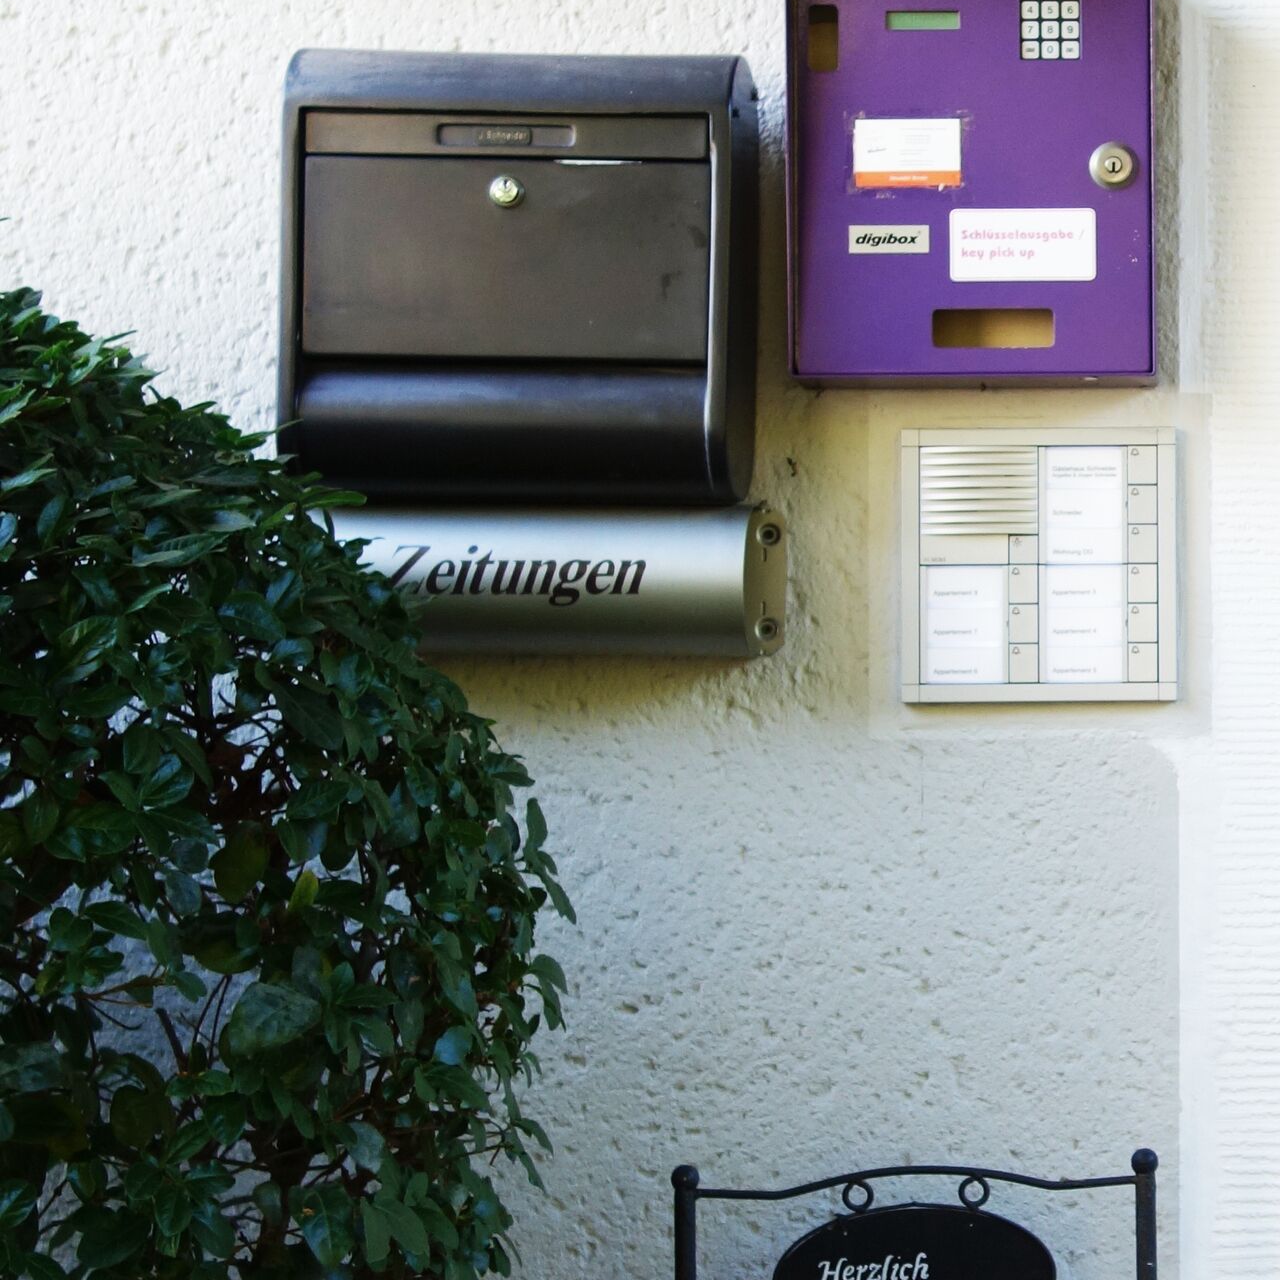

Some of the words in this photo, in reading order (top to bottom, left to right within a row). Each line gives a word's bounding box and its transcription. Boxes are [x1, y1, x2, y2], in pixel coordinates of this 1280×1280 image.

[1026, 6, 1033, 14] 4
[1047, 6, 1053, 14] 5
[1067, 6, 1073, 14] 6
[1027, 25, 1033, 33] 7
[1047, 25, 1053, 33] 8
[1067, 25, 1073, 33] 9
[1046, 45, 1054, 53] 0
[855, 233, 918, 247] digibox
[961, 229, 1074, 242] Schlüsselausgabe
[961, 247, 984, 260] key
[989, 247, 1014, 260] pick
[1019, 249, 1035, 260] up
[389, 544, 647, 607] Zeitungen
